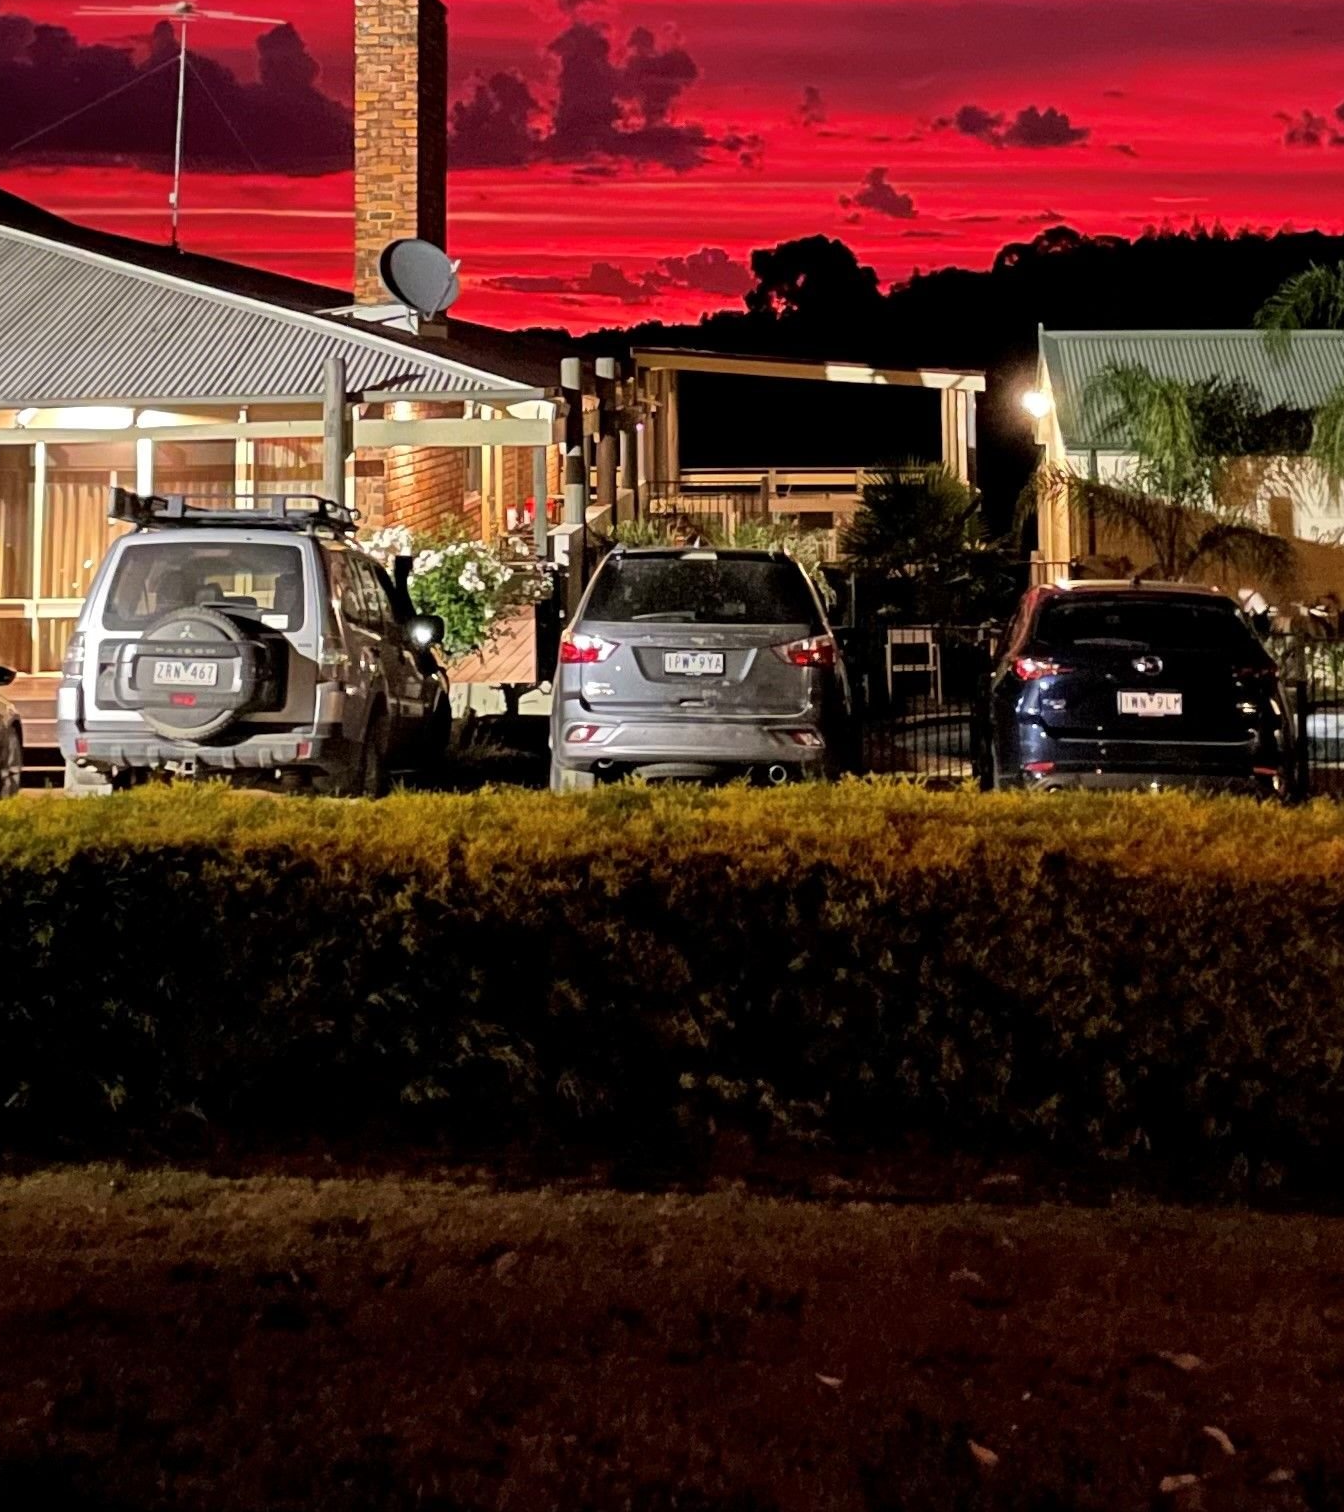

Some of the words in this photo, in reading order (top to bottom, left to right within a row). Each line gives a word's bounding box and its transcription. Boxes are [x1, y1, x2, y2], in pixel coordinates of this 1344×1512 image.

[699, 656, 722, 669] 9YA
[157, 663, 181, 679] ZRN
[190, 665, 214, 680] 467
